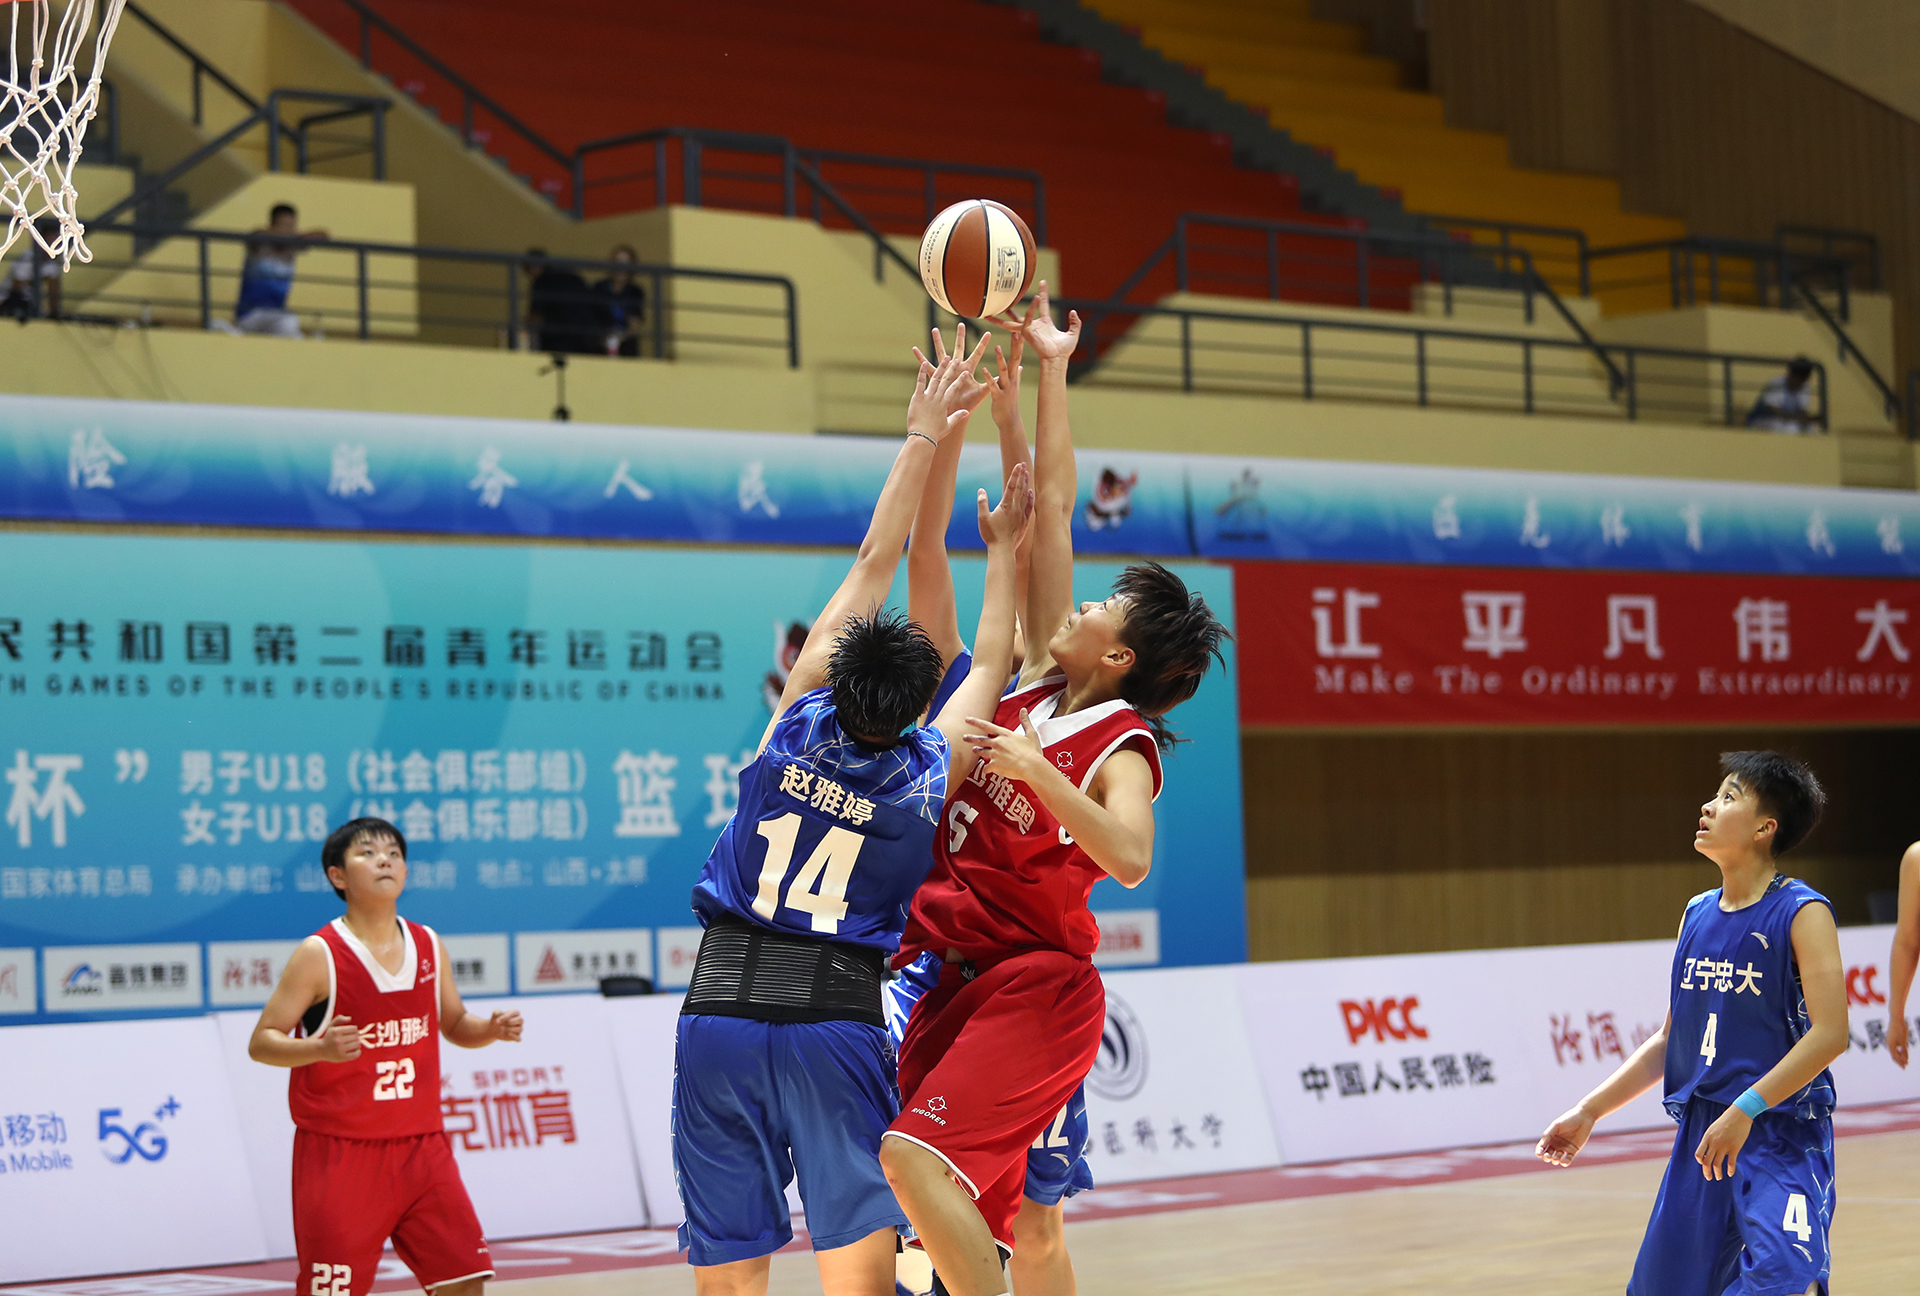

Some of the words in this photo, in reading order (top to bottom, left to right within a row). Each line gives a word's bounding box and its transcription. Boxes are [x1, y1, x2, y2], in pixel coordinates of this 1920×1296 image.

[68, 426, 127, 489] 险
[1311, 587, 1911, 663] 让平凡伟大
[46, 674, 150, 698] GAMES
[166, 675, 205, 698] OF
[223, 675, 276, 699] THE
[294, 676, 431, 700] PEOPLE'S
[446, 678, 584, 701] REPUBLIC
[596, 679, 631, 701] OF
[645, 680, 724, 701] CHINA
[1314, 664, 1415, 694] Make
[1433, 664, 1501, 694] The
[1521, 665, 1677, 700] Ordinary
[1697, 667, 1912, 699] Extraordinary
[779, 763, 877, 826] 赵雅婷
[751, 811, 866, 935] 14
[1680, 957, 1763, 997] 辽宁忠大
[1339, 994, 1429, 1046] PICC
[1700, 1012, 1718, 1067] 4
[373, 1057, 416, 1101] 22
[472, 1065, 565, 1090] SPORT
[1299, 1050, 1496, 1101] 中国人民保险
[0, 1111, 68, 1148] 移动
[911, 1107, 947, 1127] RIGORER
[10, 1149, 74, 1173] Mobile
[1782, 1192, 1812, 1242] 4
[312, 1262, 352, 1296] 22
